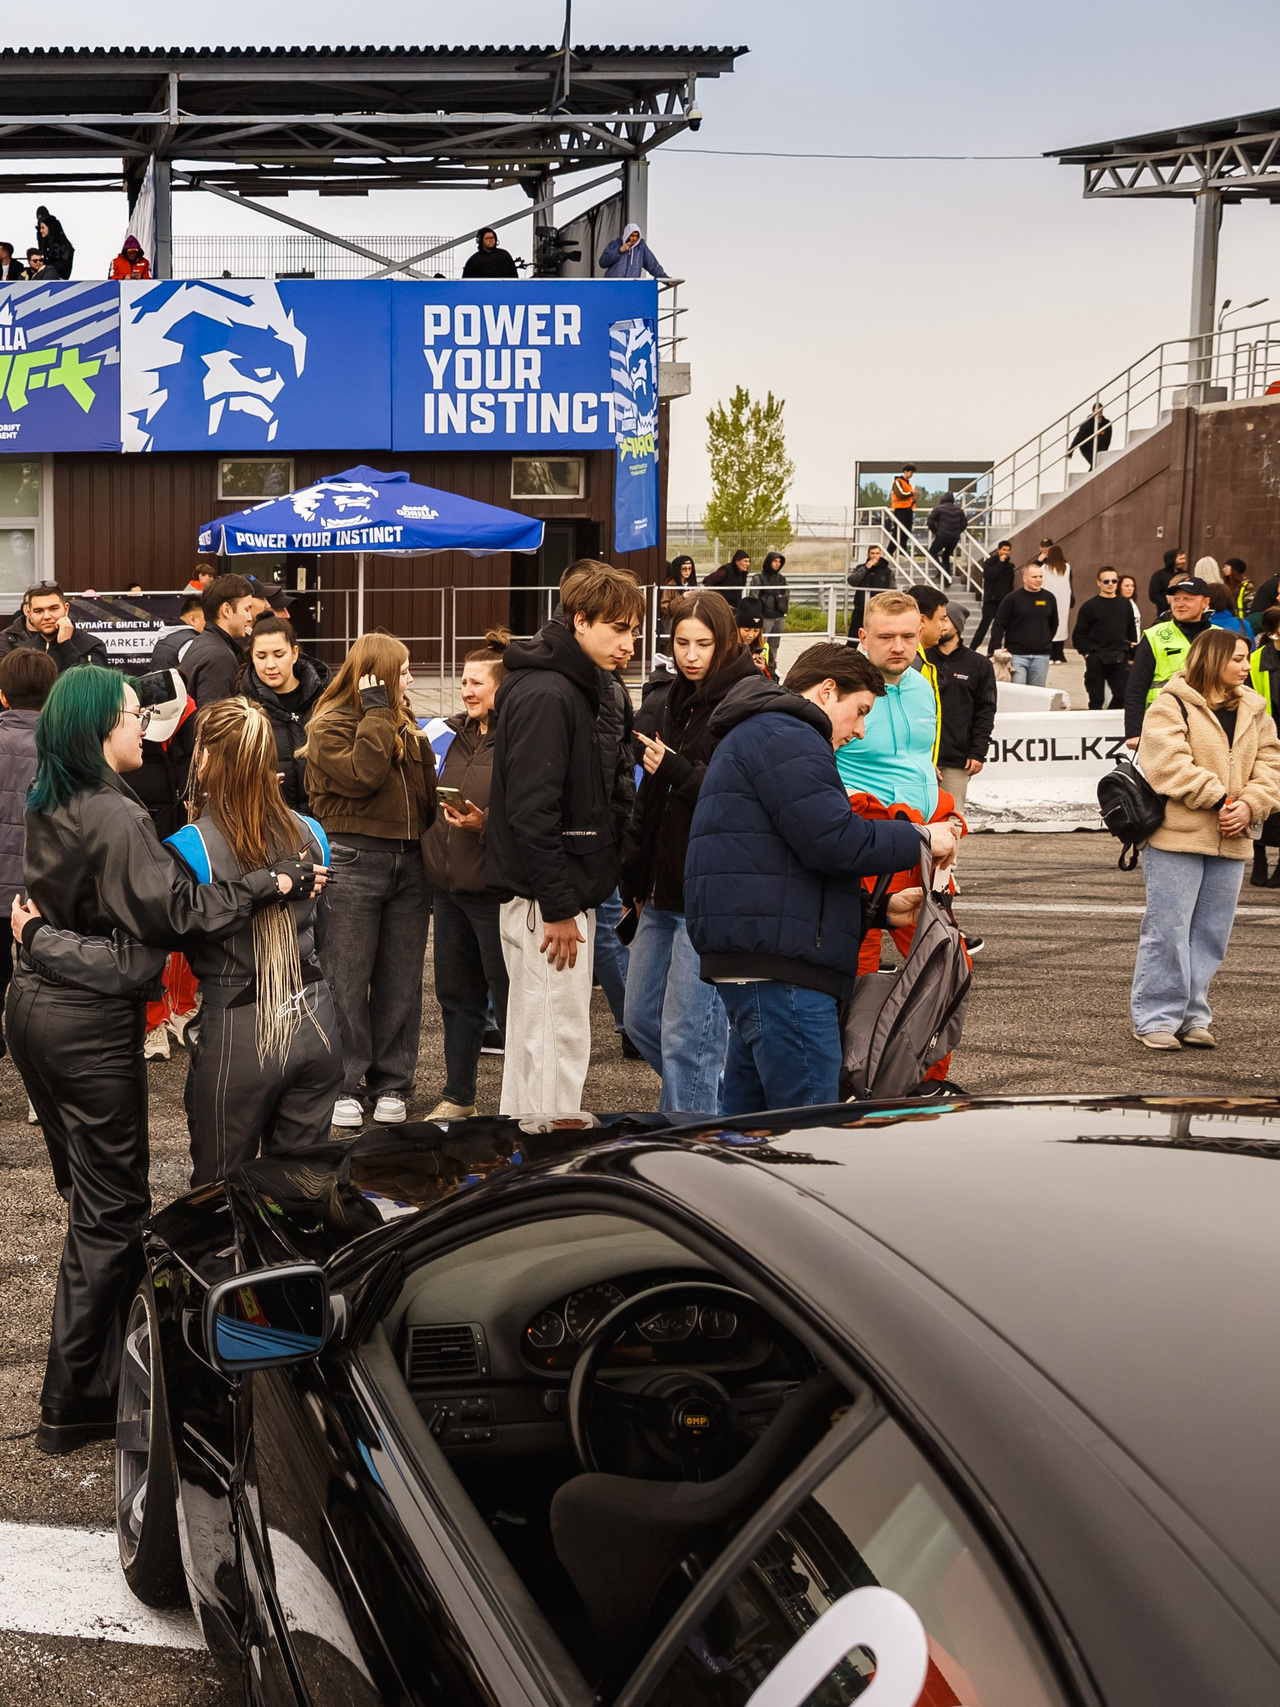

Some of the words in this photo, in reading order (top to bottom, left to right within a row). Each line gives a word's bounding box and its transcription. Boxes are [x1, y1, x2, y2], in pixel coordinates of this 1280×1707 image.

[423, 304, 581, 346] POWER
[422, 348, 542, 390] YOUR
[423, 392, 616, 434] INSTINCT
[235, 532, 287, 548] POWER
[291, 530, 331, 548] YOUR
[335, 526, 404, 546] INSTINCT
[116, 621, 150, 629] БИЛЕТЫ
[153, 620, 165, 628] НА
[686, 1417, 707, 1425] OMP
